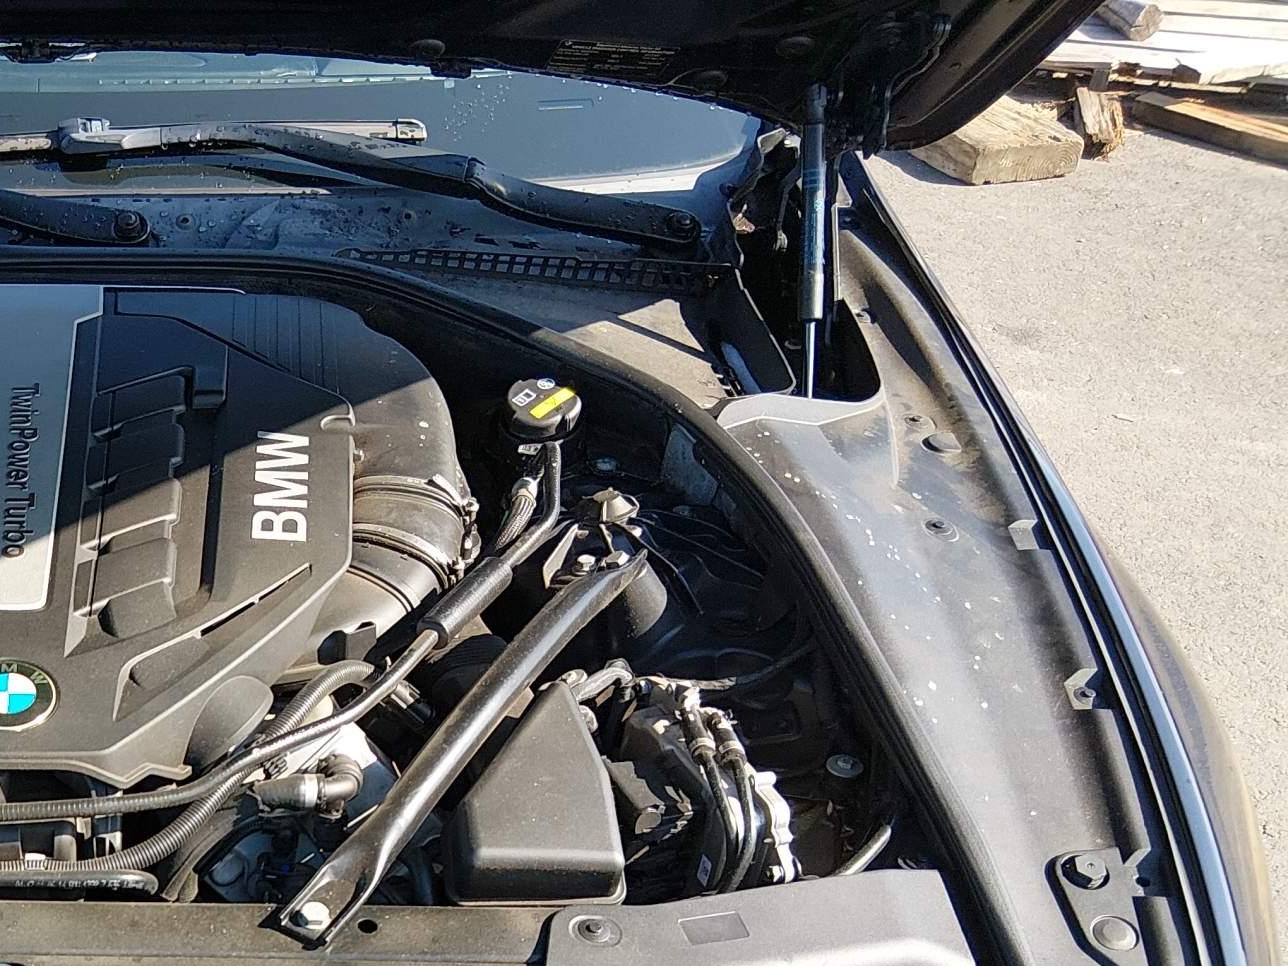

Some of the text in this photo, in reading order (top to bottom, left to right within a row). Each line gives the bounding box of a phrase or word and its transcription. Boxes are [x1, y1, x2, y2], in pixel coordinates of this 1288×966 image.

[2, 382, 40, 558] TwinPower Turbo
[252, 430, 309, 542] BMW
